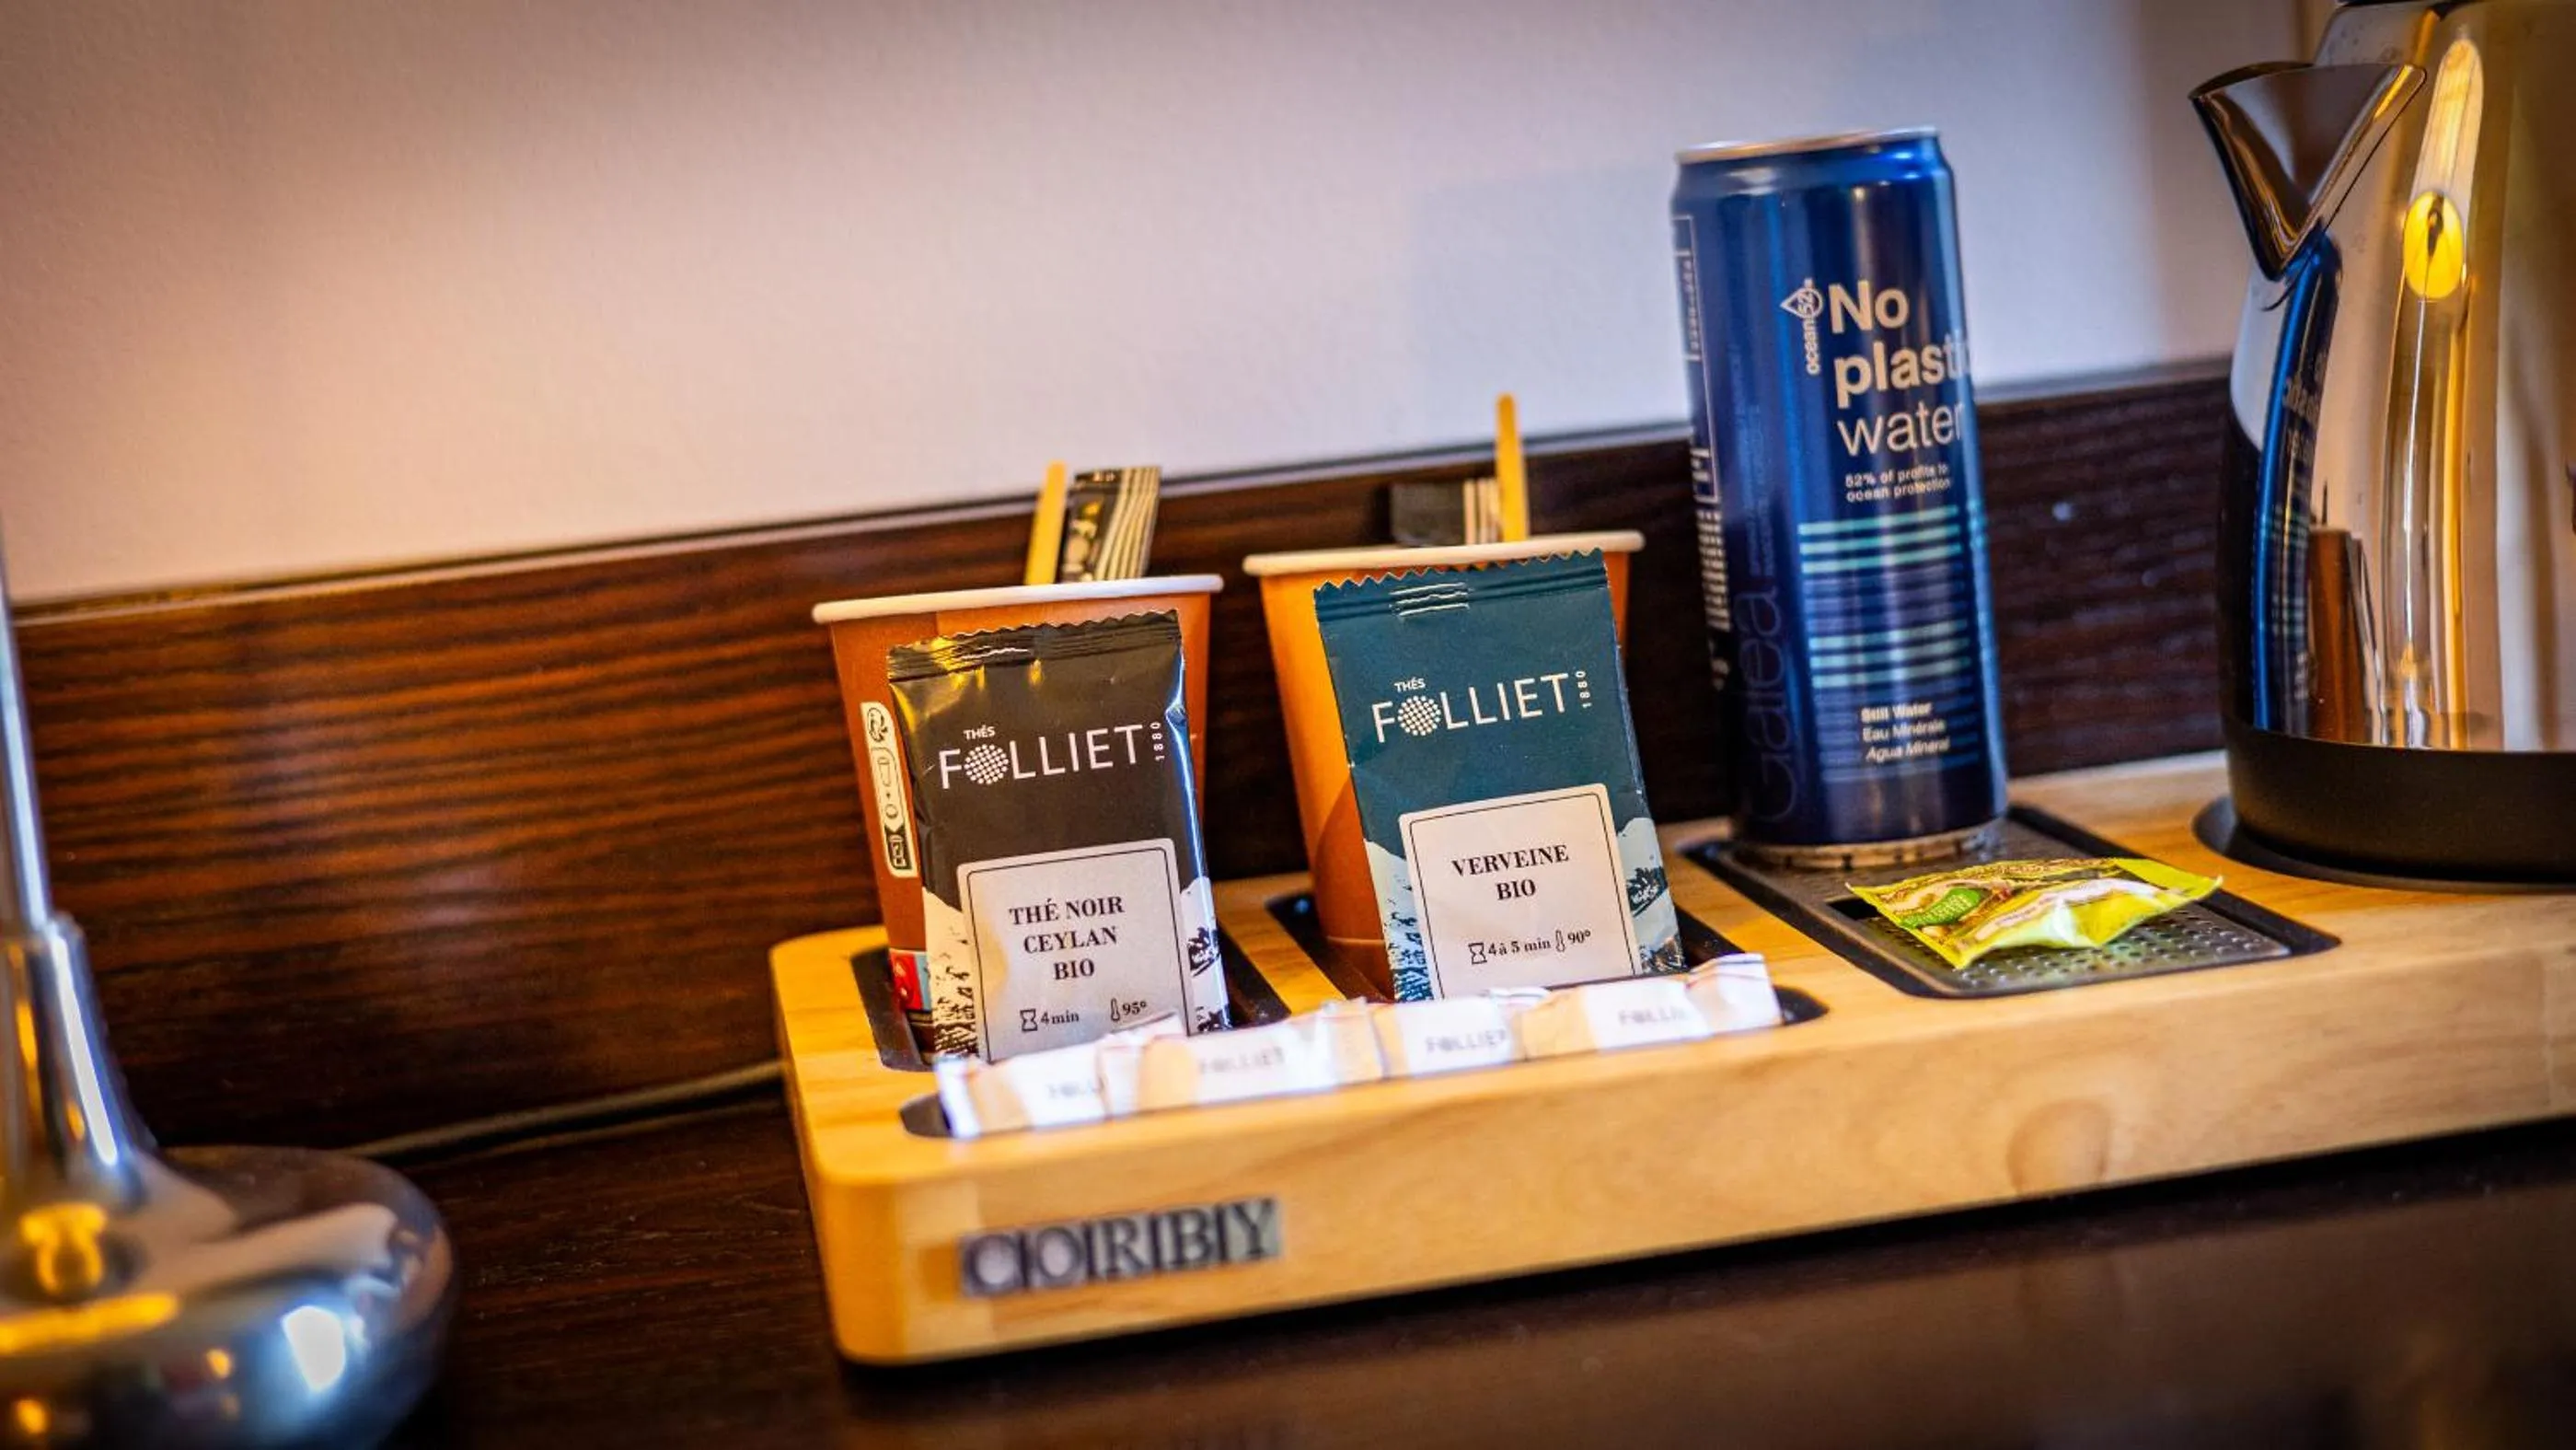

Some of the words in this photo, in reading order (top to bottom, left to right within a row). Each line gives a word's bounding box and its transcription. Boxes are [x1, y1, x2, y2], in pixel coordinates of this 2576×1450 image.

[1828, 279, 1909, 334] No
[1837, 400, 1965, 458] water
[1845, 472, 1877, 489] 52%
[1879, 469, 1895, 485] of
[1897, 463, 1936, 484] profits
[1846, 486, 1891, 504] ocean
[1893, 478, 1951, 499] protection
[1394, 676, 1427, 693] THÉS
[1575, 669, 1593, 710] 1880
[1371, 672, 1569, 744] FOLLIET
[1892, 702, 1933, 719] Water
[964, 724, 997, 740] THÉS
[1150, 721, 1166, 762] 1880
[1863, 725, 1889, 743] Eau
[939, 724, 1144, 790] FOLLIET
[1866, 745, 1903, 764] Agua
[1451, 843, 1570, 876] VERVEINE
[1496, 878, 1537, 901] BIO
[1008, 898, 1059, 926] THÉ
[1066, 896, 1126, 921] NOIR
[1022, 925, 1119, 955] CEYLAN
[1510, 940, 1520, 955] 5
[1523, 936, 1552, 953] min
[1053, 957, 1096, 981] BIO
[965, 1198, 1276, 1296] CORBY
